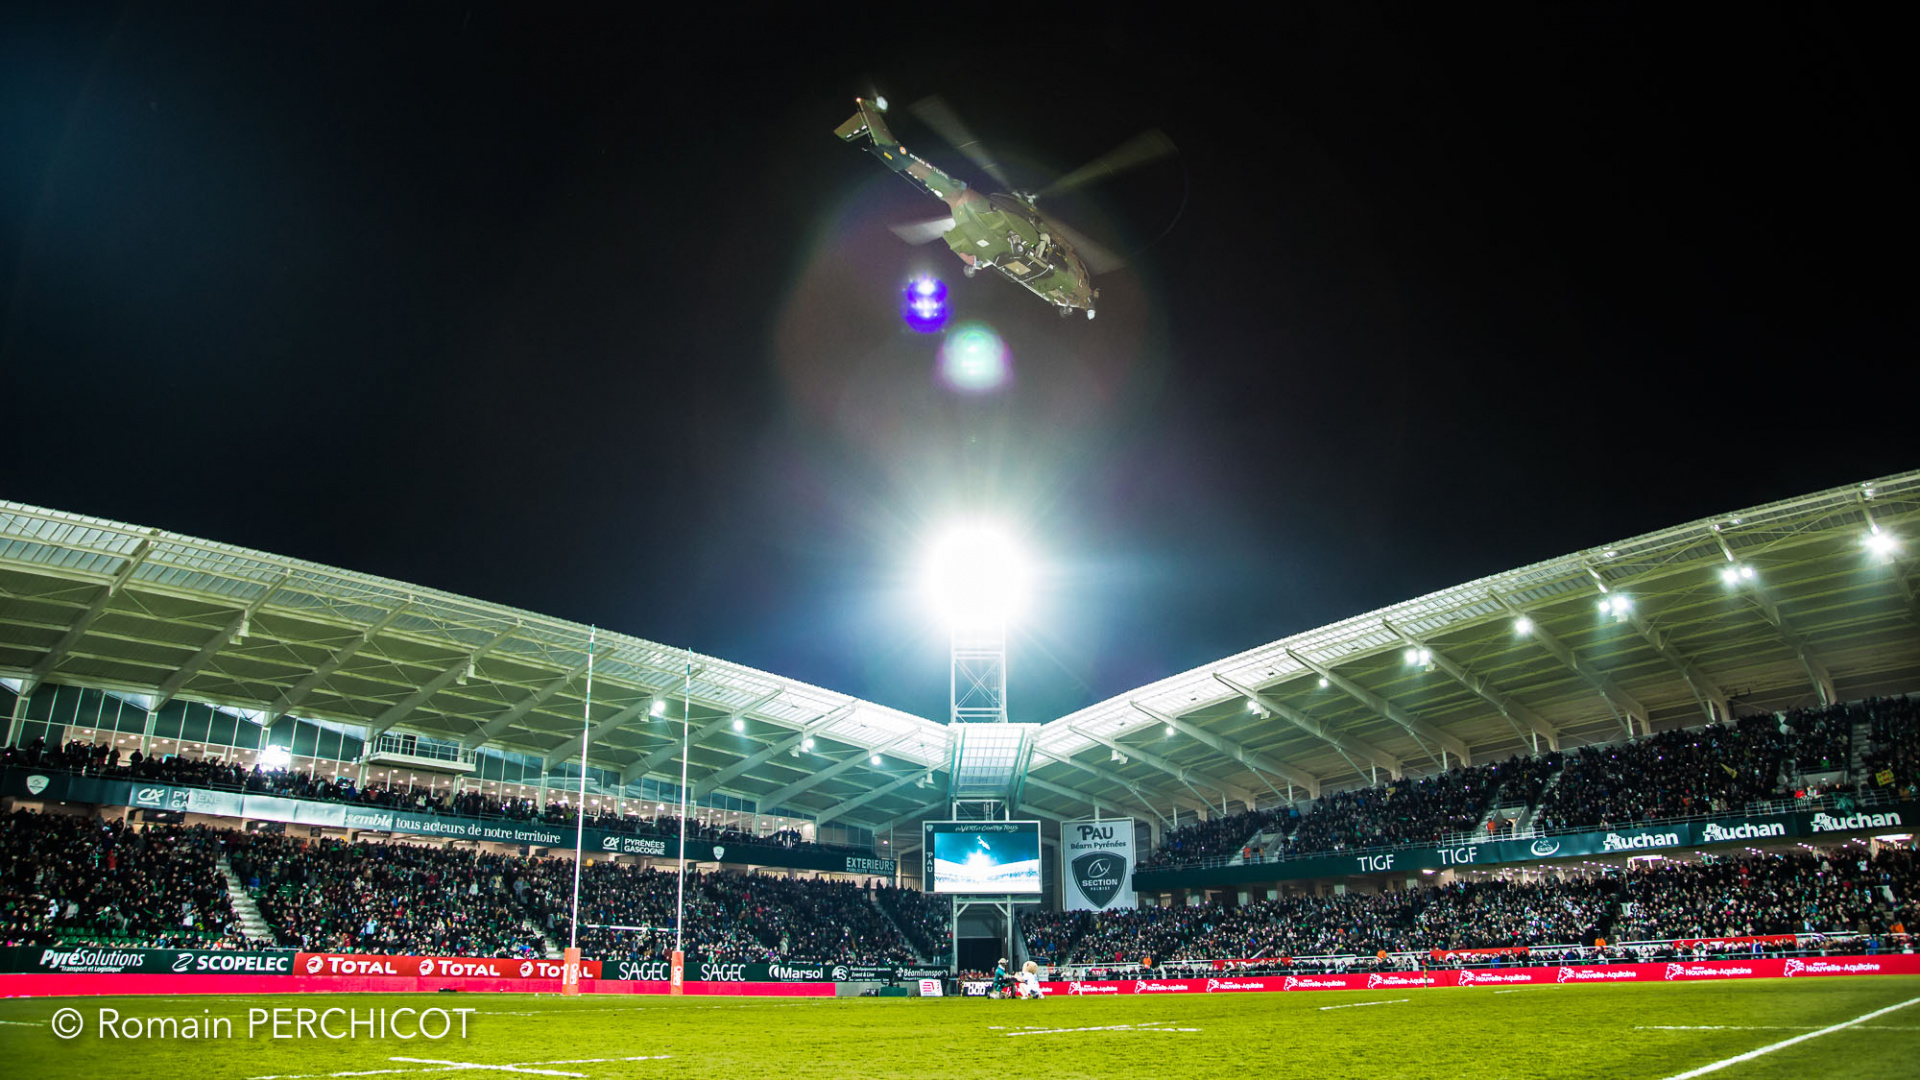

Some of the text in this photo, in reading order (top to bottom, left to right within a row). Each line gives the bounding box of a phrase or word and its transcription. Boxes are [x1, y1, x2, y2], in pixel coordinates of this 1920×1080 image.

[1810, 811, 1902, 832] Auchan
[395, 817, 421, 830] tous
[423, 820, 466, 834] acteurs
[467, 823, 482, 836] de
[484, 826, 513, 839] notre
[514, 829, 561, 844] territoire
[1077, 825, 1114, 840] PAU
[1702, 822, 1785, 842] Auchan
[624, 837, 665, 849] PYRÉNÉES
[1070, 839, 1127, 850] Béarn Pyrénées
[1603, 832, 1679, 850] Auchan
[624, 845, 665, 856] GASCOGNE
[1437, 846, 1478, 865] TIGF
[846, 856, 895, 871] EXTERIEURS
[1357, 854, 1395, 872] TIGF
[1082, 879, 1118, 887] SECTION
[39, 947, 146, 968] PyréSolutions
[196, 955, 289, 972] SCOPELEC
[327, 957, 398, 975] TOTAL
[438, 960, 501, 976] TOTAL
[618, 961, 669, 981] SAGEC
[700, 963, 747, 981] SAGEC
[780, 967, 824, 979] Marsol
[1686, 967, 1752, 977] Nouvelle-Aquitaine
[1806, 963, 1880, 973] Nouvelle-Aquitaine
[1475, 974, 1532, 983] Nouvelle-Aquitaine
[1575, 970, 1637, 980] Nouvelle-Aquitaine
